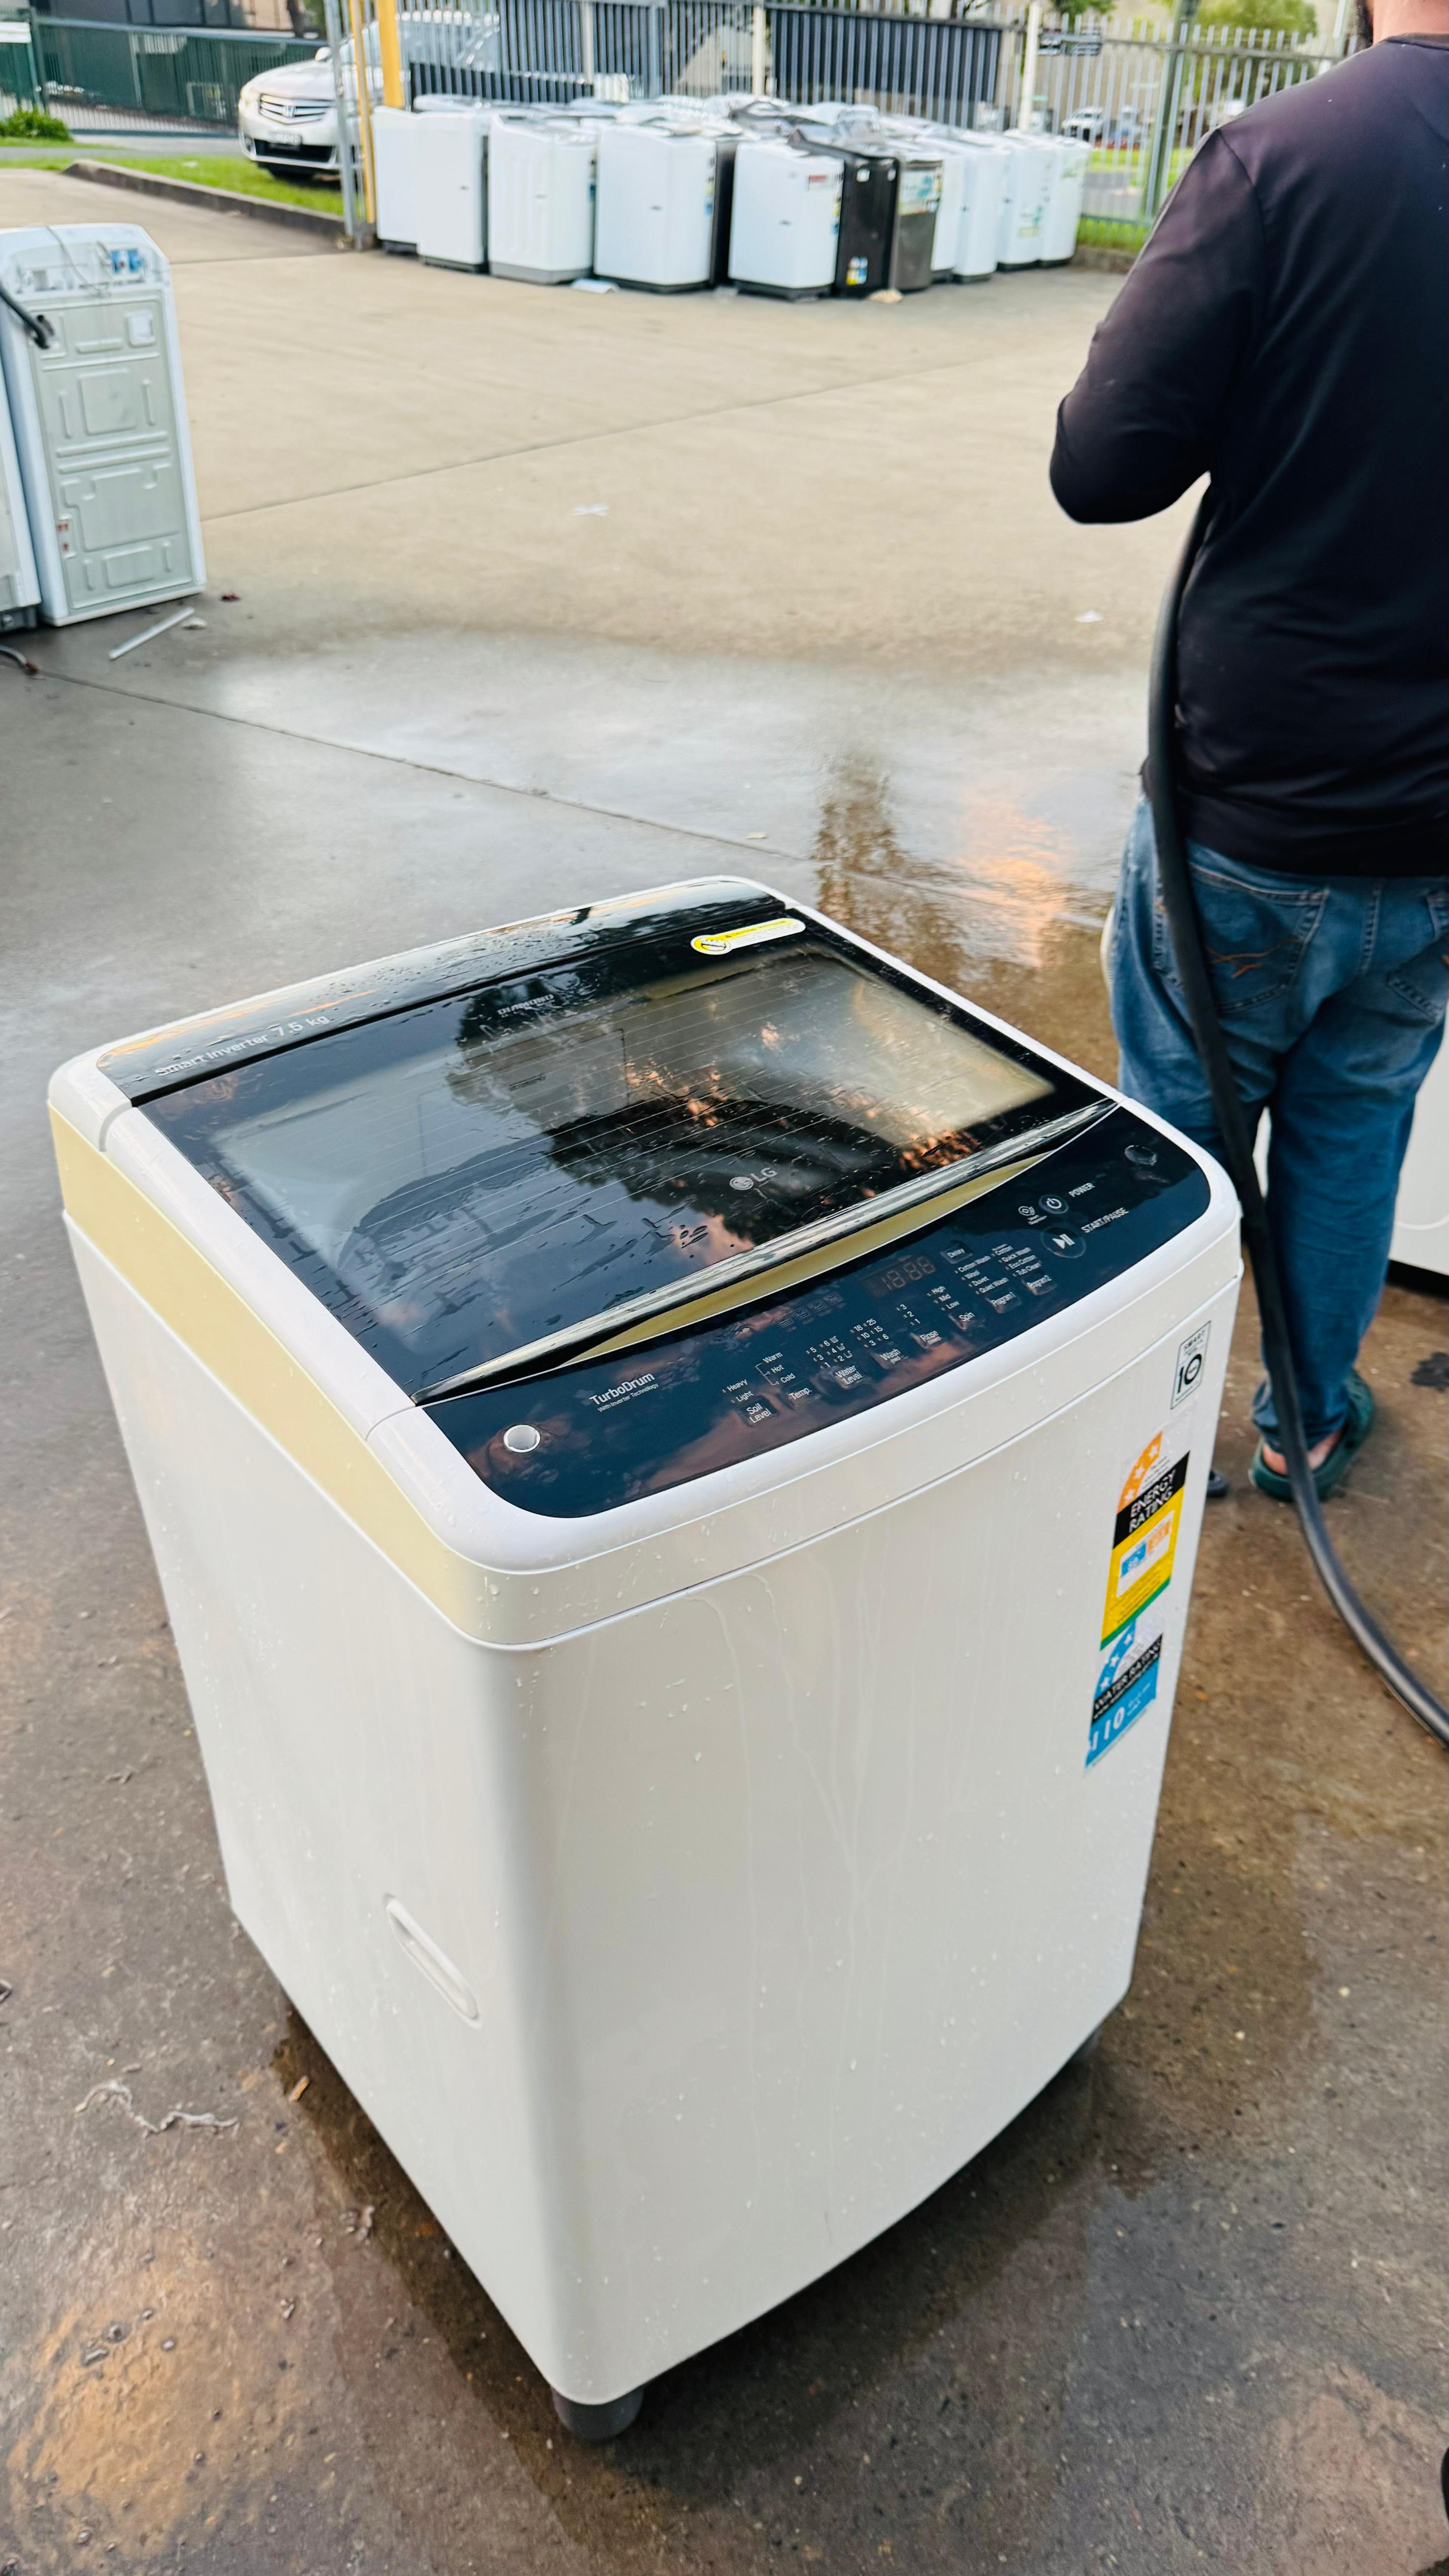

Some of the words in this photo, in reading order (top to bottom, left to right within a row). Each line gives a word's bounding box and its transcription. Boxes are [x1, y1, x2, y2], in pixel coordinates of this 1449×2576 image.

[155, 1055, 209, 1076] Smart
[206, 1034, 268, 1059] Inverter
[272, 1022, 304, 1037] 7.5
[305, 1015, 330, 1027] kg
[750, 1168, 778, 1182] LG
[1068, 1182, 1095, 1197] POWER
[931, 1286, 946, 1295] High
[939, 1294, 951, 1302] Mid
[946, 1301, 960, 1309] Low
[958, 1312, 976, 1322] Spin
[920, 1330, 939, 1342] Rinse
[763, 1352, 783, 1363] Warm
[880, 1349, 901, 1360] Wash
[771, 1364, 785, 1374] Hot
[835, 1365, 856, 1378] Water
[1177, 1353, 1202, 1394] 10
[780, 1373, 796, 1383] Cold
[843, 1372, 863, 1384] Level
[589, 1374, 655, 1405] TurboDrum
[727, 1379, 748, 1392] Heavy
[736, 1391, 754, 1402] Light
[788, 1387, 813, 1400] Temp.
[746, 1403, 763, 1415] Soil
[749, 1408, 772, 1423] Level
[1131, 1469, 1176, 1518] ENERGY
[1129, 1486, 1173, 1533] RATING
